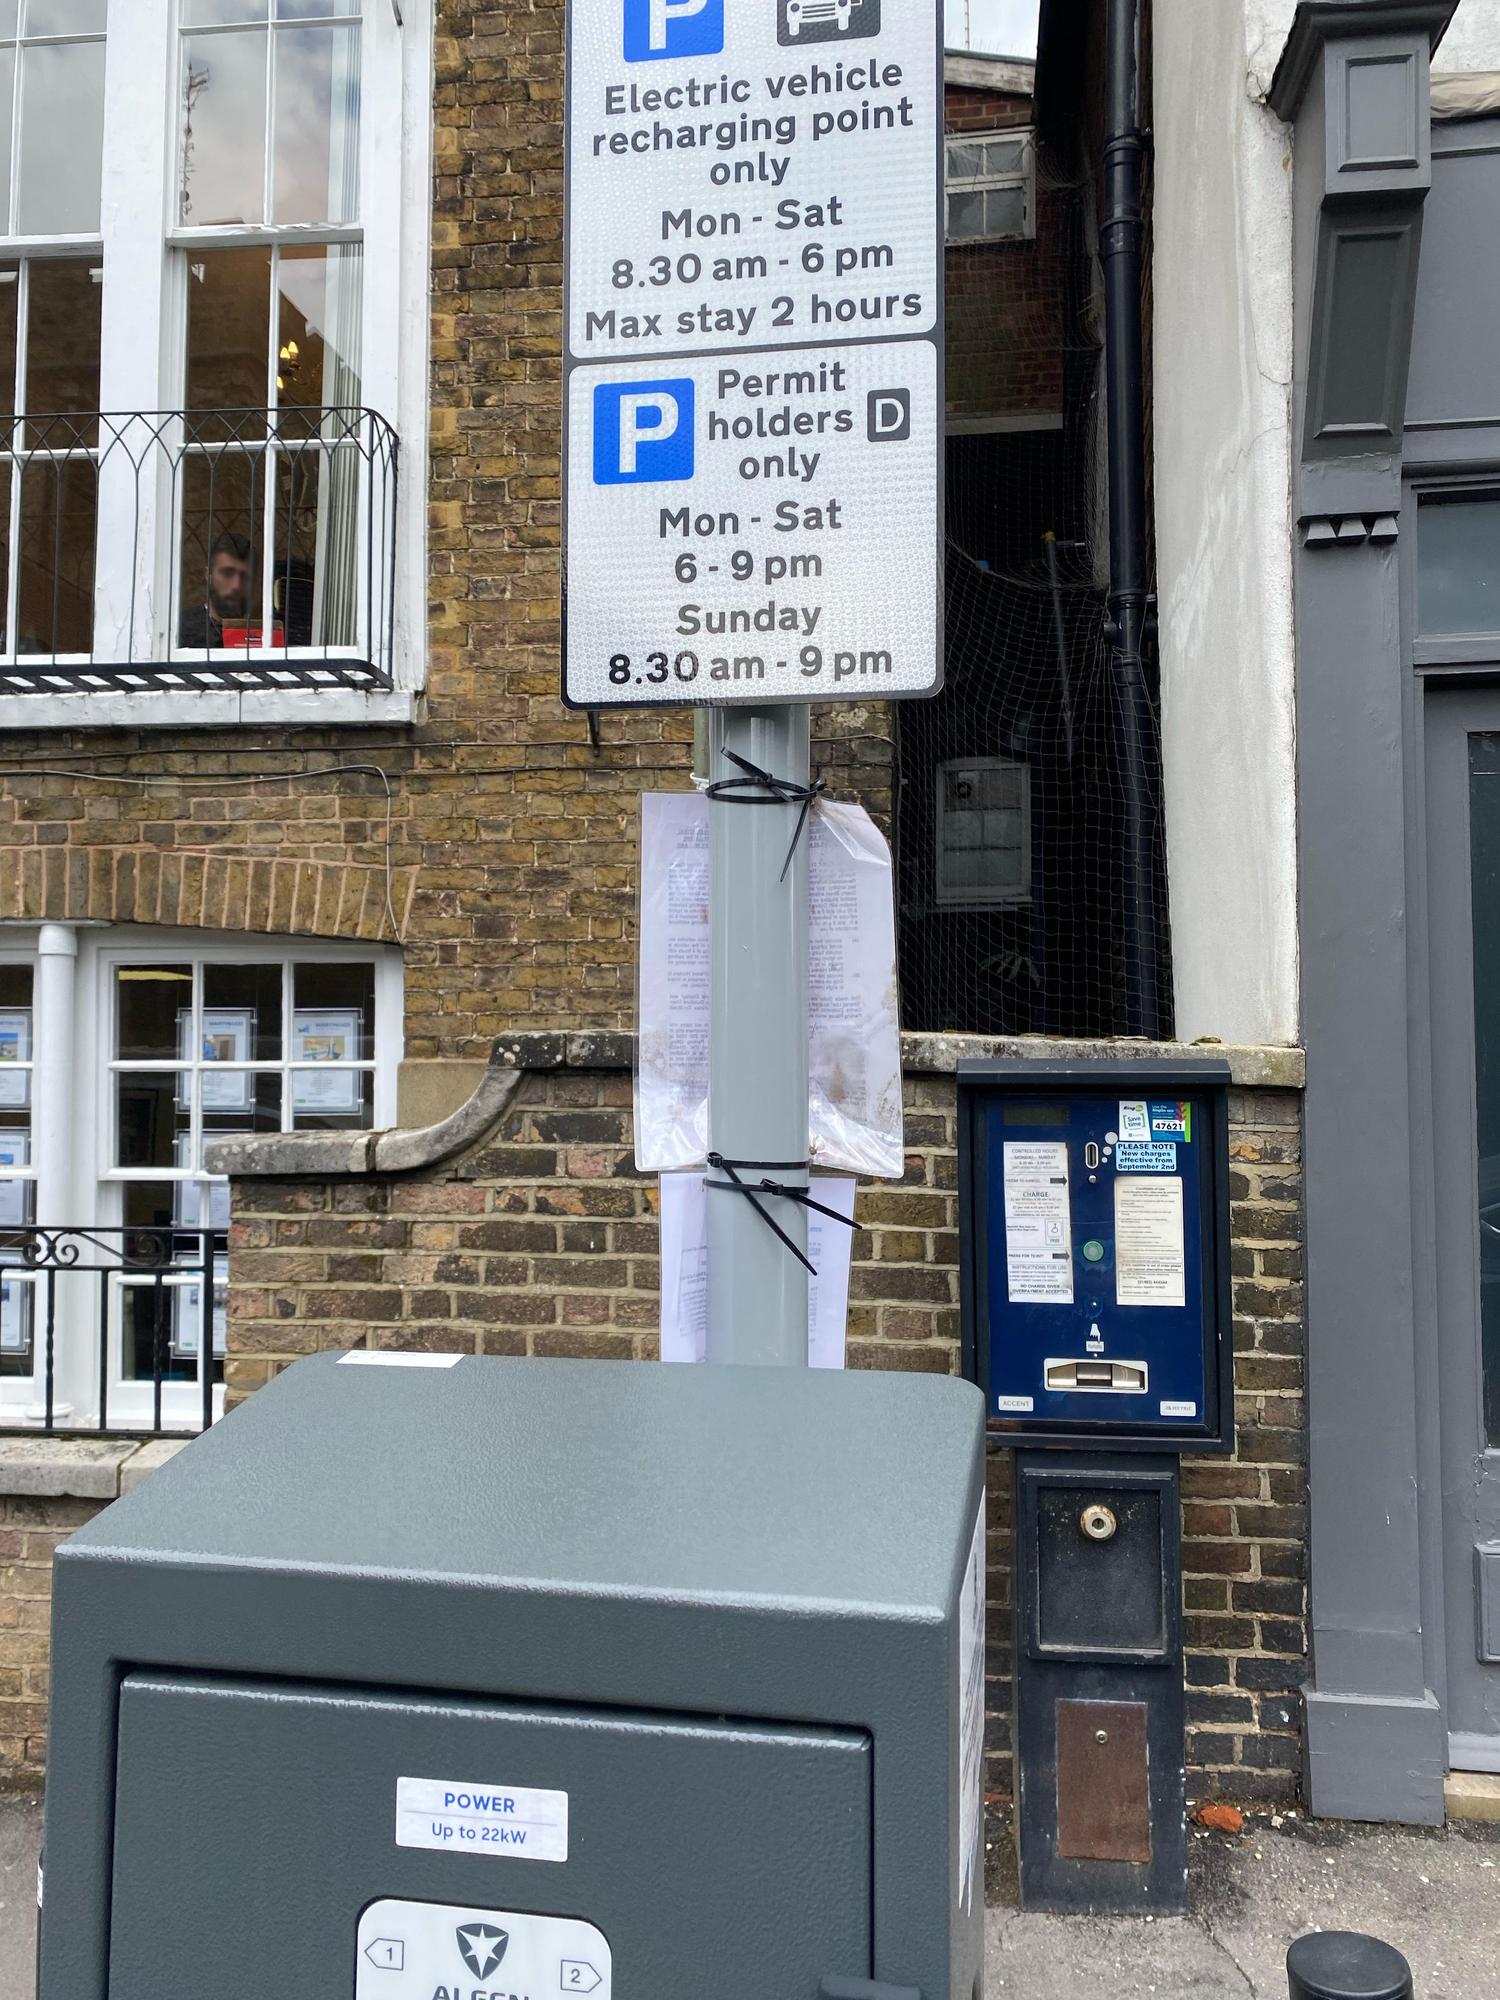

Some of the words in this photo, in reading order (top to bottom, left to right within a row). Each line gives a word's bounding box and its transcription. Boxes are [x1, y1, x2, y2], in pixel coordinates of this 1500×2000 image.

[606, 75, 750, 116] Electric
[765, 59, 902, 98] vehicle
[594, 111, 795, 157] recharging
[813, 96, 913, 141] point
[710, 151, 790, 186] only
[662, 209, 740, 240] Mon
[775, 196, 842, 230] Sat
[612, 253, 701, 289] 8.30
[713, 256, 766, 281] am
[802, 243, 824, 273] 6
[836, 245, 893, 276] pm
[586, 310, 662, 341] Max
[677, 303, 756, 335] stay
[772, 296, 794, 326] 2
[812, 294, 921, 323] hours
[719, 362, 846, 399] Permit
[709, 406, 853, 440] holders
[875, 397, 905, 433] D
[619, 392, 679, 474] P
[739, 447, 820, 482] only
[660, 507, 738, 538] Mon
[773, 499, 842, 532] Sat
[675, 553, 697, 583] 6
[731, 550, 753, 581] 9
[765, 555, 821, 585] pm
[676, 601, 821, 636] Sunday
[609, 651, 699, 684] 8.30
[710, 657, 764, 681] am
[800, 645, 822, 677] 9
[834, 650, 892, 681] pm
[1155, 1122, 1182, 1131] 47621
[1117, 1163, 1159, 1171] September
[1140, 1150, 1171, 1158] charges
[1003, 1400, 1030, 1408] ACCENT
[445, 1793, 514, 1813] POWER
[432, 1823, 453, 1840] Up
[459, 1826, 476, 1839] to
[482, 1827, 526, 1844] 22kW
[570, 1968, 581, 1984] 2
